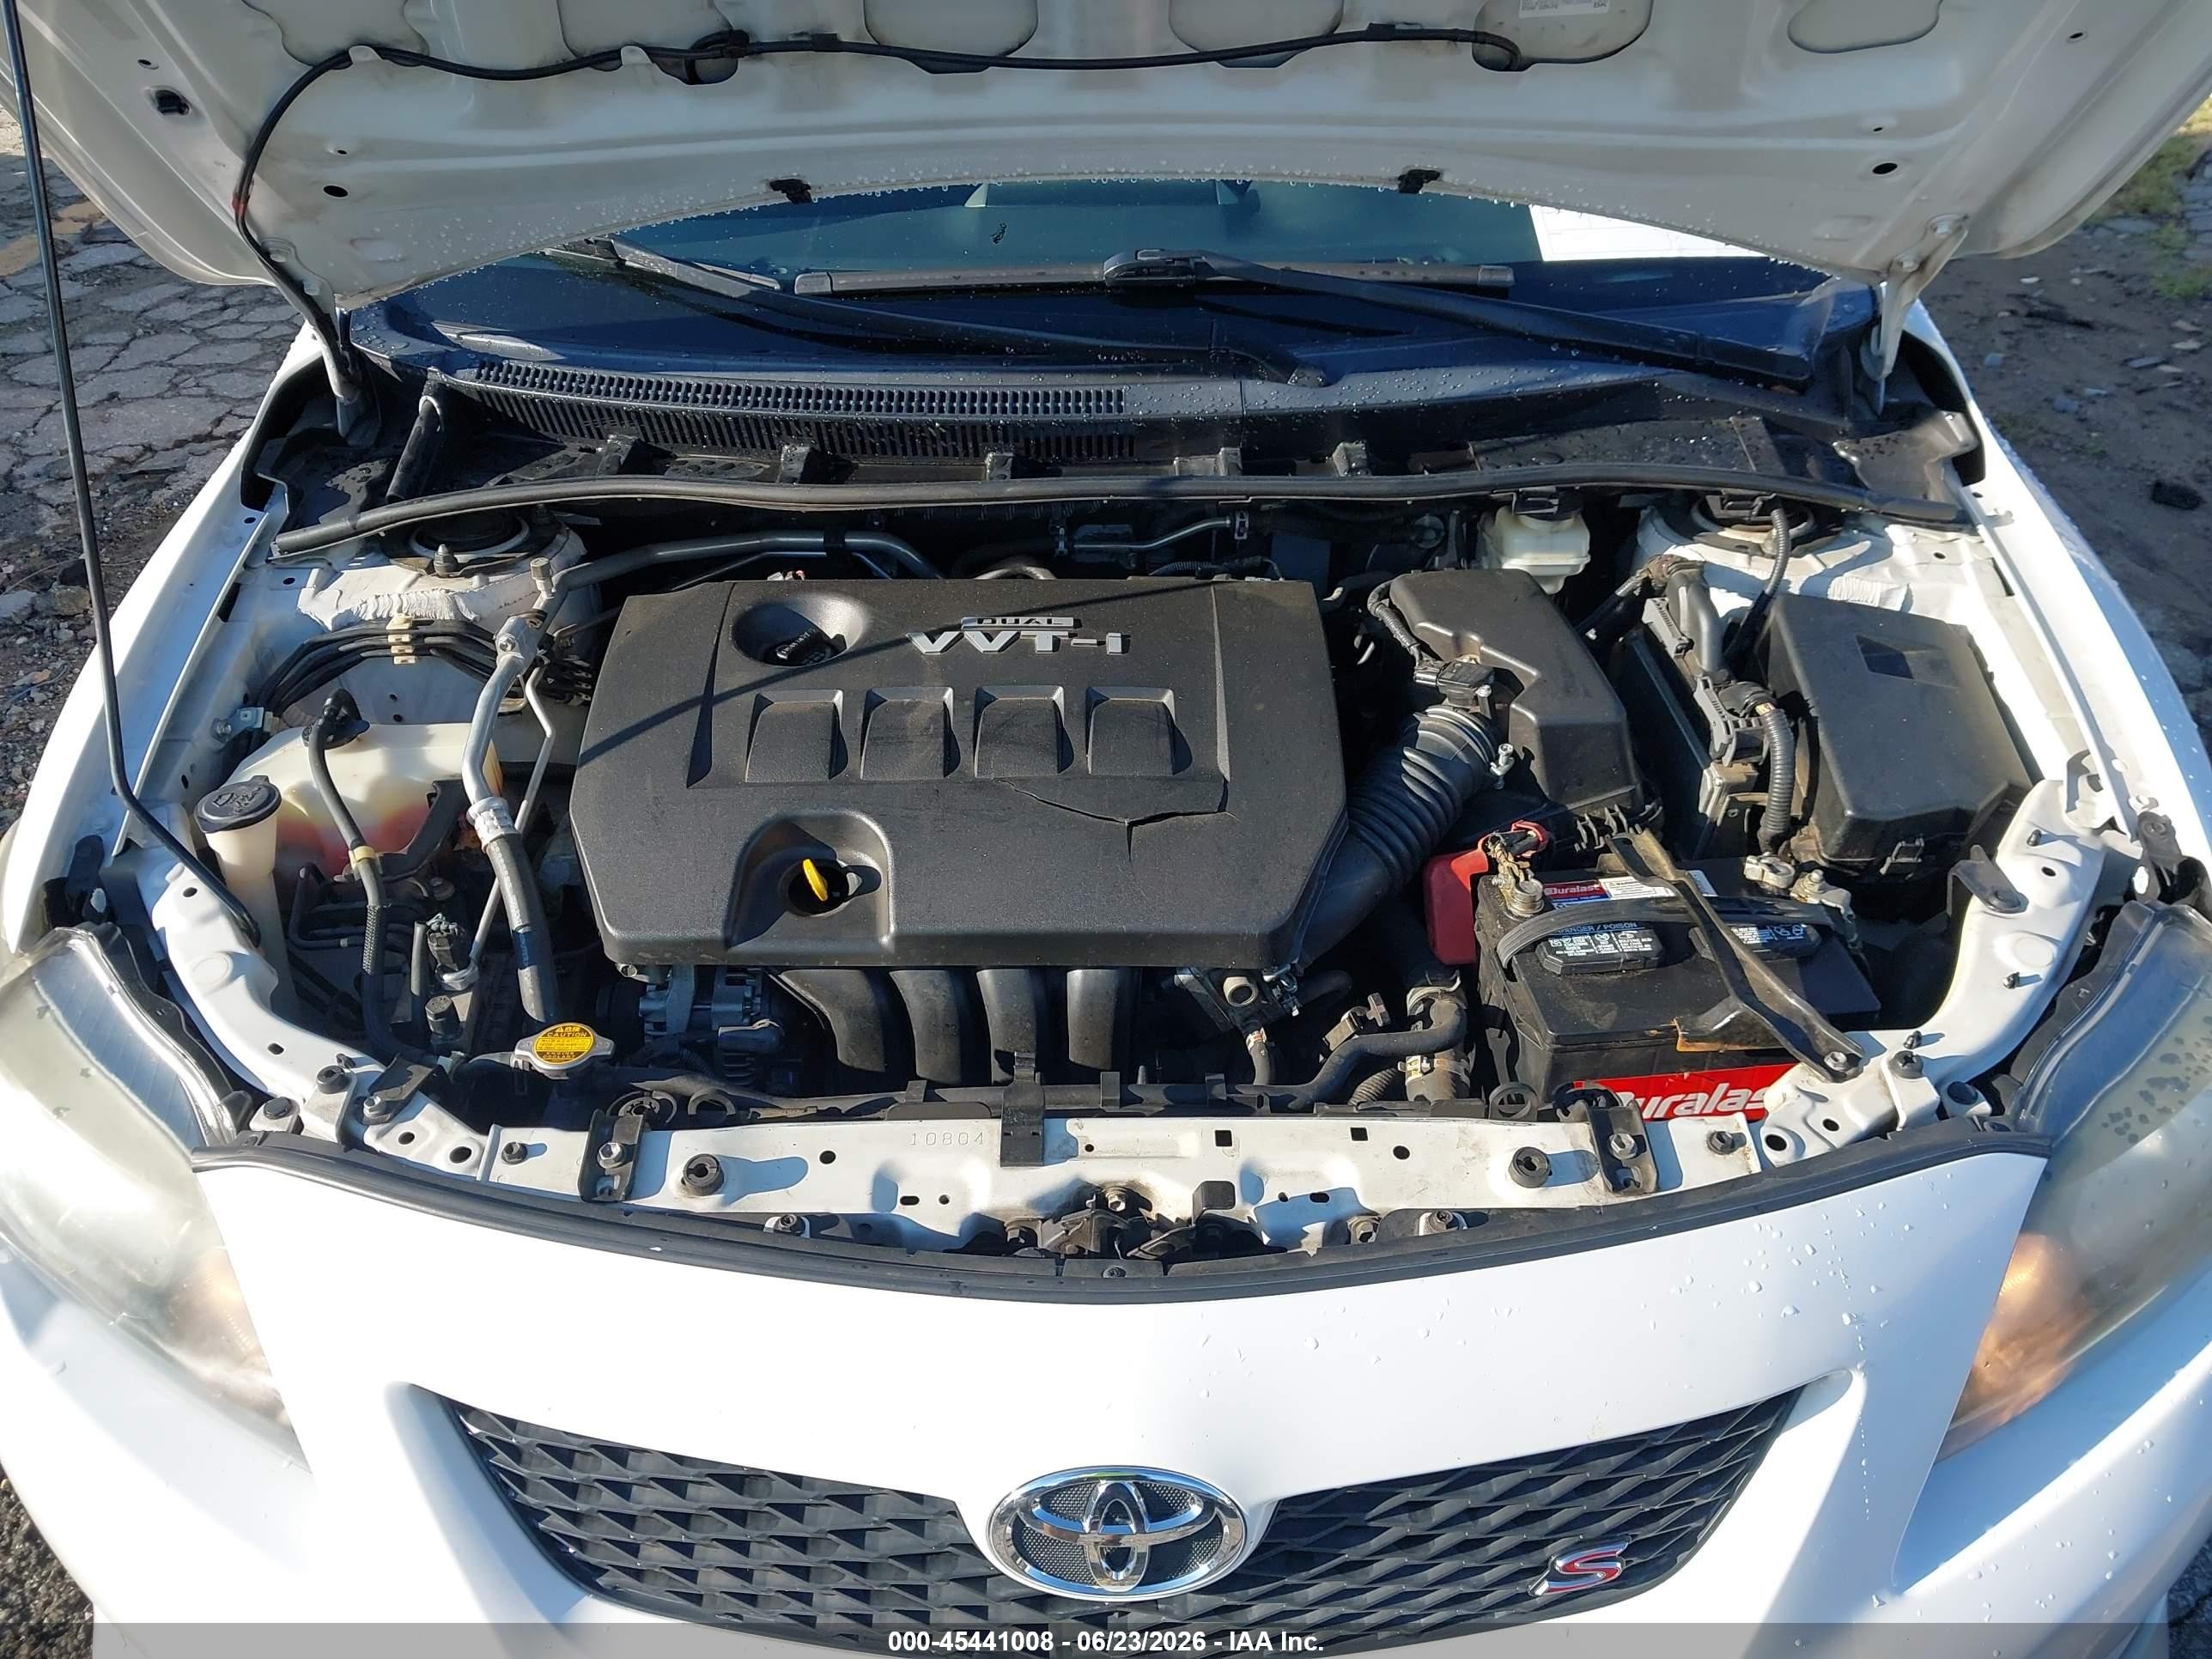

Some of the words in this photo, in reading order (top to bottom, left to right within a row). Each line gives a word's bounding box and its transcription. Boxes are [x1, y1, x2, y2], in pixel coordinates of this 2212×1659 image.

[975, 617, 1066, 627] DUAL
[1544, 883, 1601, 896] Duralast
[1603, 921, 1638, 930] POISON
[1617, 1083, 1766, 1118] uralas
[909, 1131, 985, 1146] 10804
[1533, 1541, 1629, 1595] S
